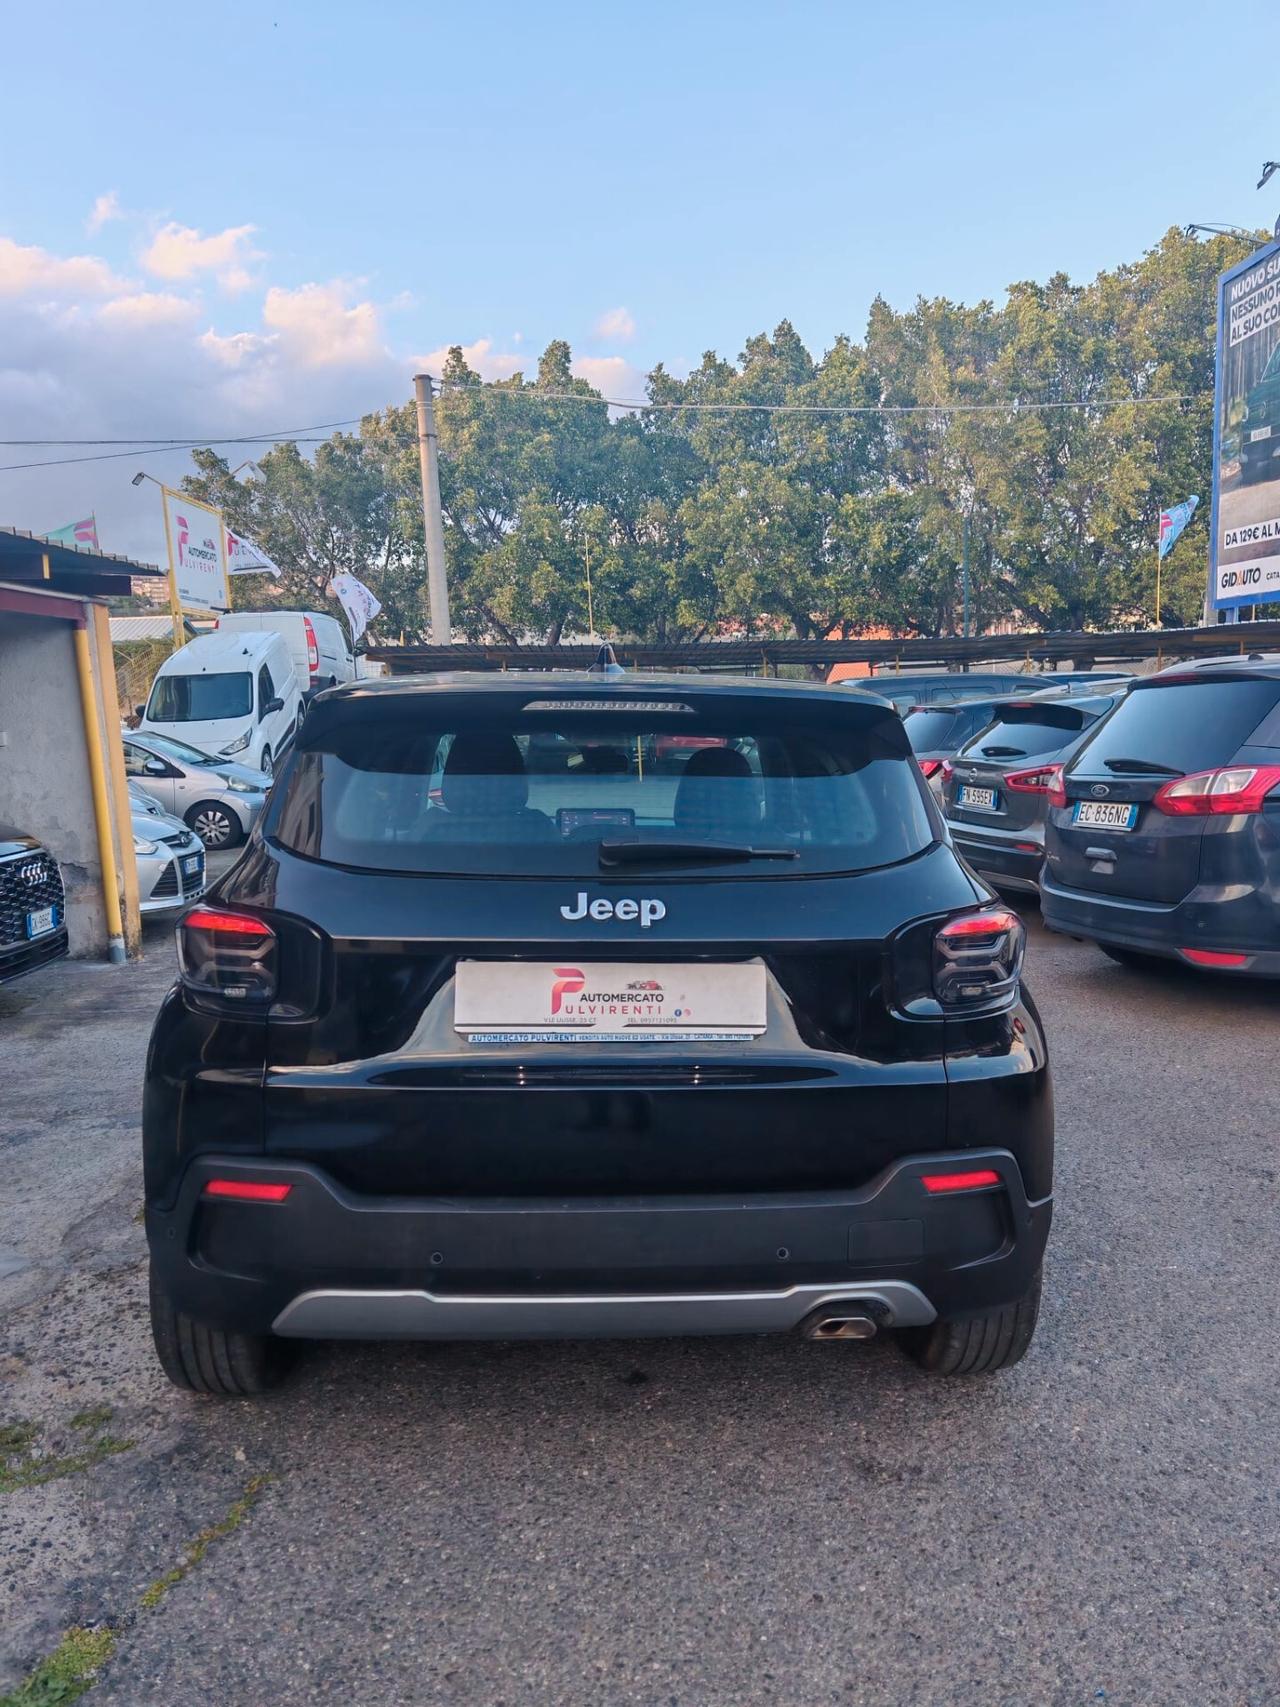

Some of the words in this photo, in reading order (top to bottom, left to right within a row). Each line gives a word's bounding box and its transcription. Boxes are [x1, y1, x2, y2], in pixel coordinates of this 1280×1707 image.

[1231, 267, 1266, 301] NUOVO
[1231, 286, 1275, 323] NESSUNO
[1231, 325, 1242, 342] AL
[1243, 313, 1262, 336] SUO
[1225, 532, 1238, 546] DA
[1240, 527, 1260, 543] 129€
[1261, 524, 1273, 539] AL
[1079, 804, 1093, 822] EC
[1094, 805, 1129, 824] 836NG
[560, 892, 666, 928] Jeep
[580, 993, 664, 1003] AUTOMERCATO
[471, 1034, 529, 1042] AUTOMERCATO
[531, 1033, 577, 1041] PULVIRENTI
